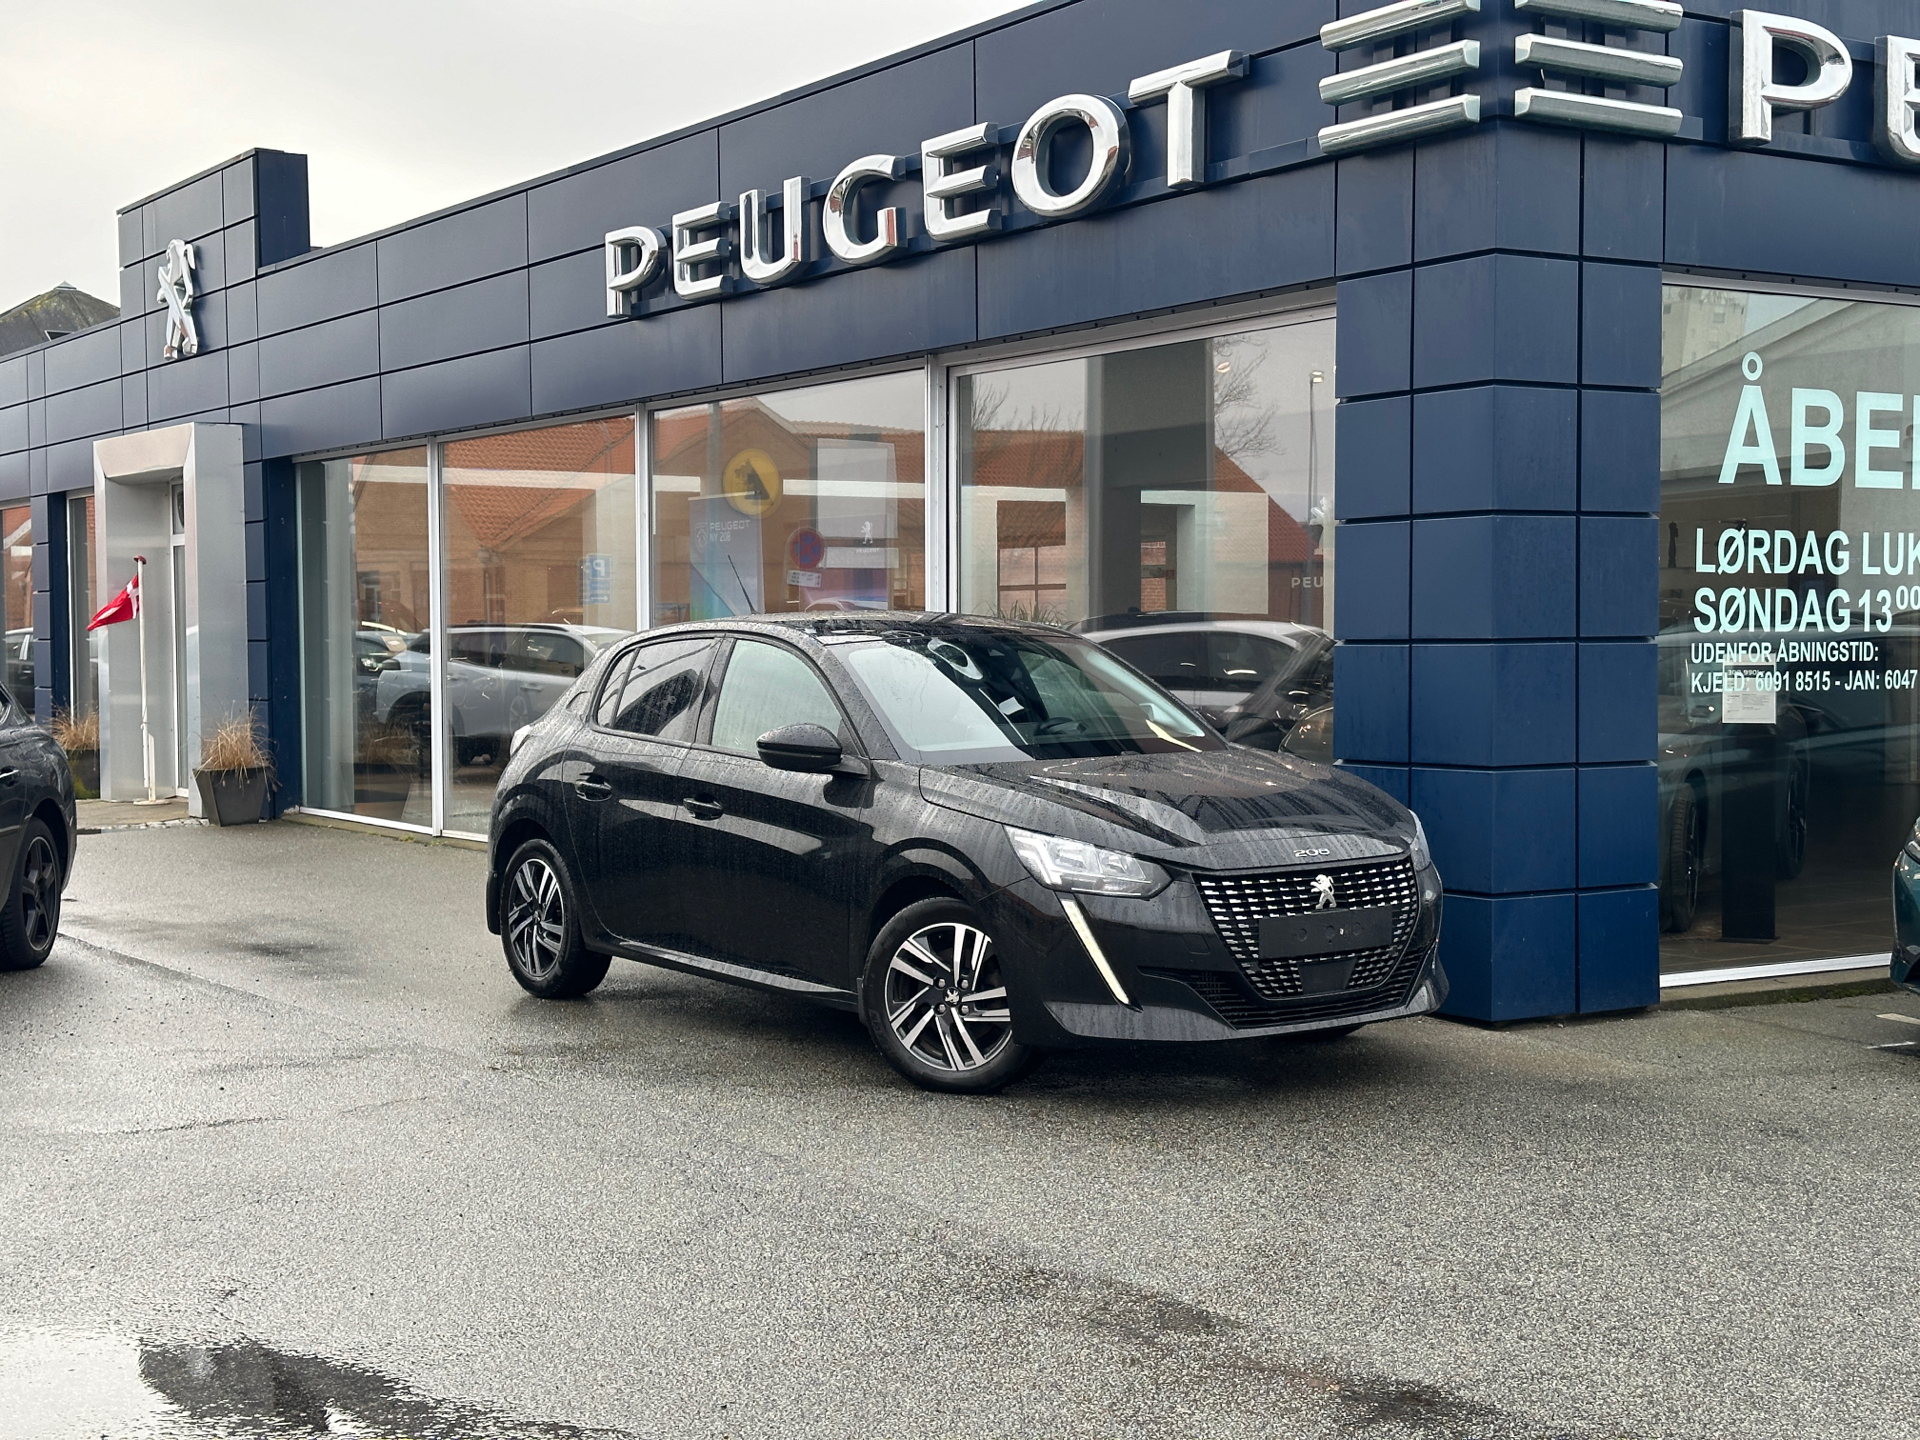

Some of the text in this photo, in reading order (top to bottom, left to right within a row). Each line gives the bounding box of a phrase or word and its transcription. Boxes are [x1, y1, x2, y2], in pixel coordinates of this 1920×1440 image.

[605, 48, 1243, 318] PEUGEOT
[1718, 351, 1920, 490] ÅBE
[709, 520, 750, 531] PEUGEOT
[720, 531, 731, 542] 208
[1695, 528, 1850, 575] LØRDAG
[1694, 587, 1850, 634] SØNDAG
[1691, 638, 1878, 663] UDENFOR ÅBNINGSTID:
[1691, 671, 1750, 693] KJELD:
[1755, 671, 1790, 692] 6091
[1795, 671, 1831, 692] 8515
[1844, 669, 1880, 691] JAN:
[1884, 668, 1919, 690] 6047
